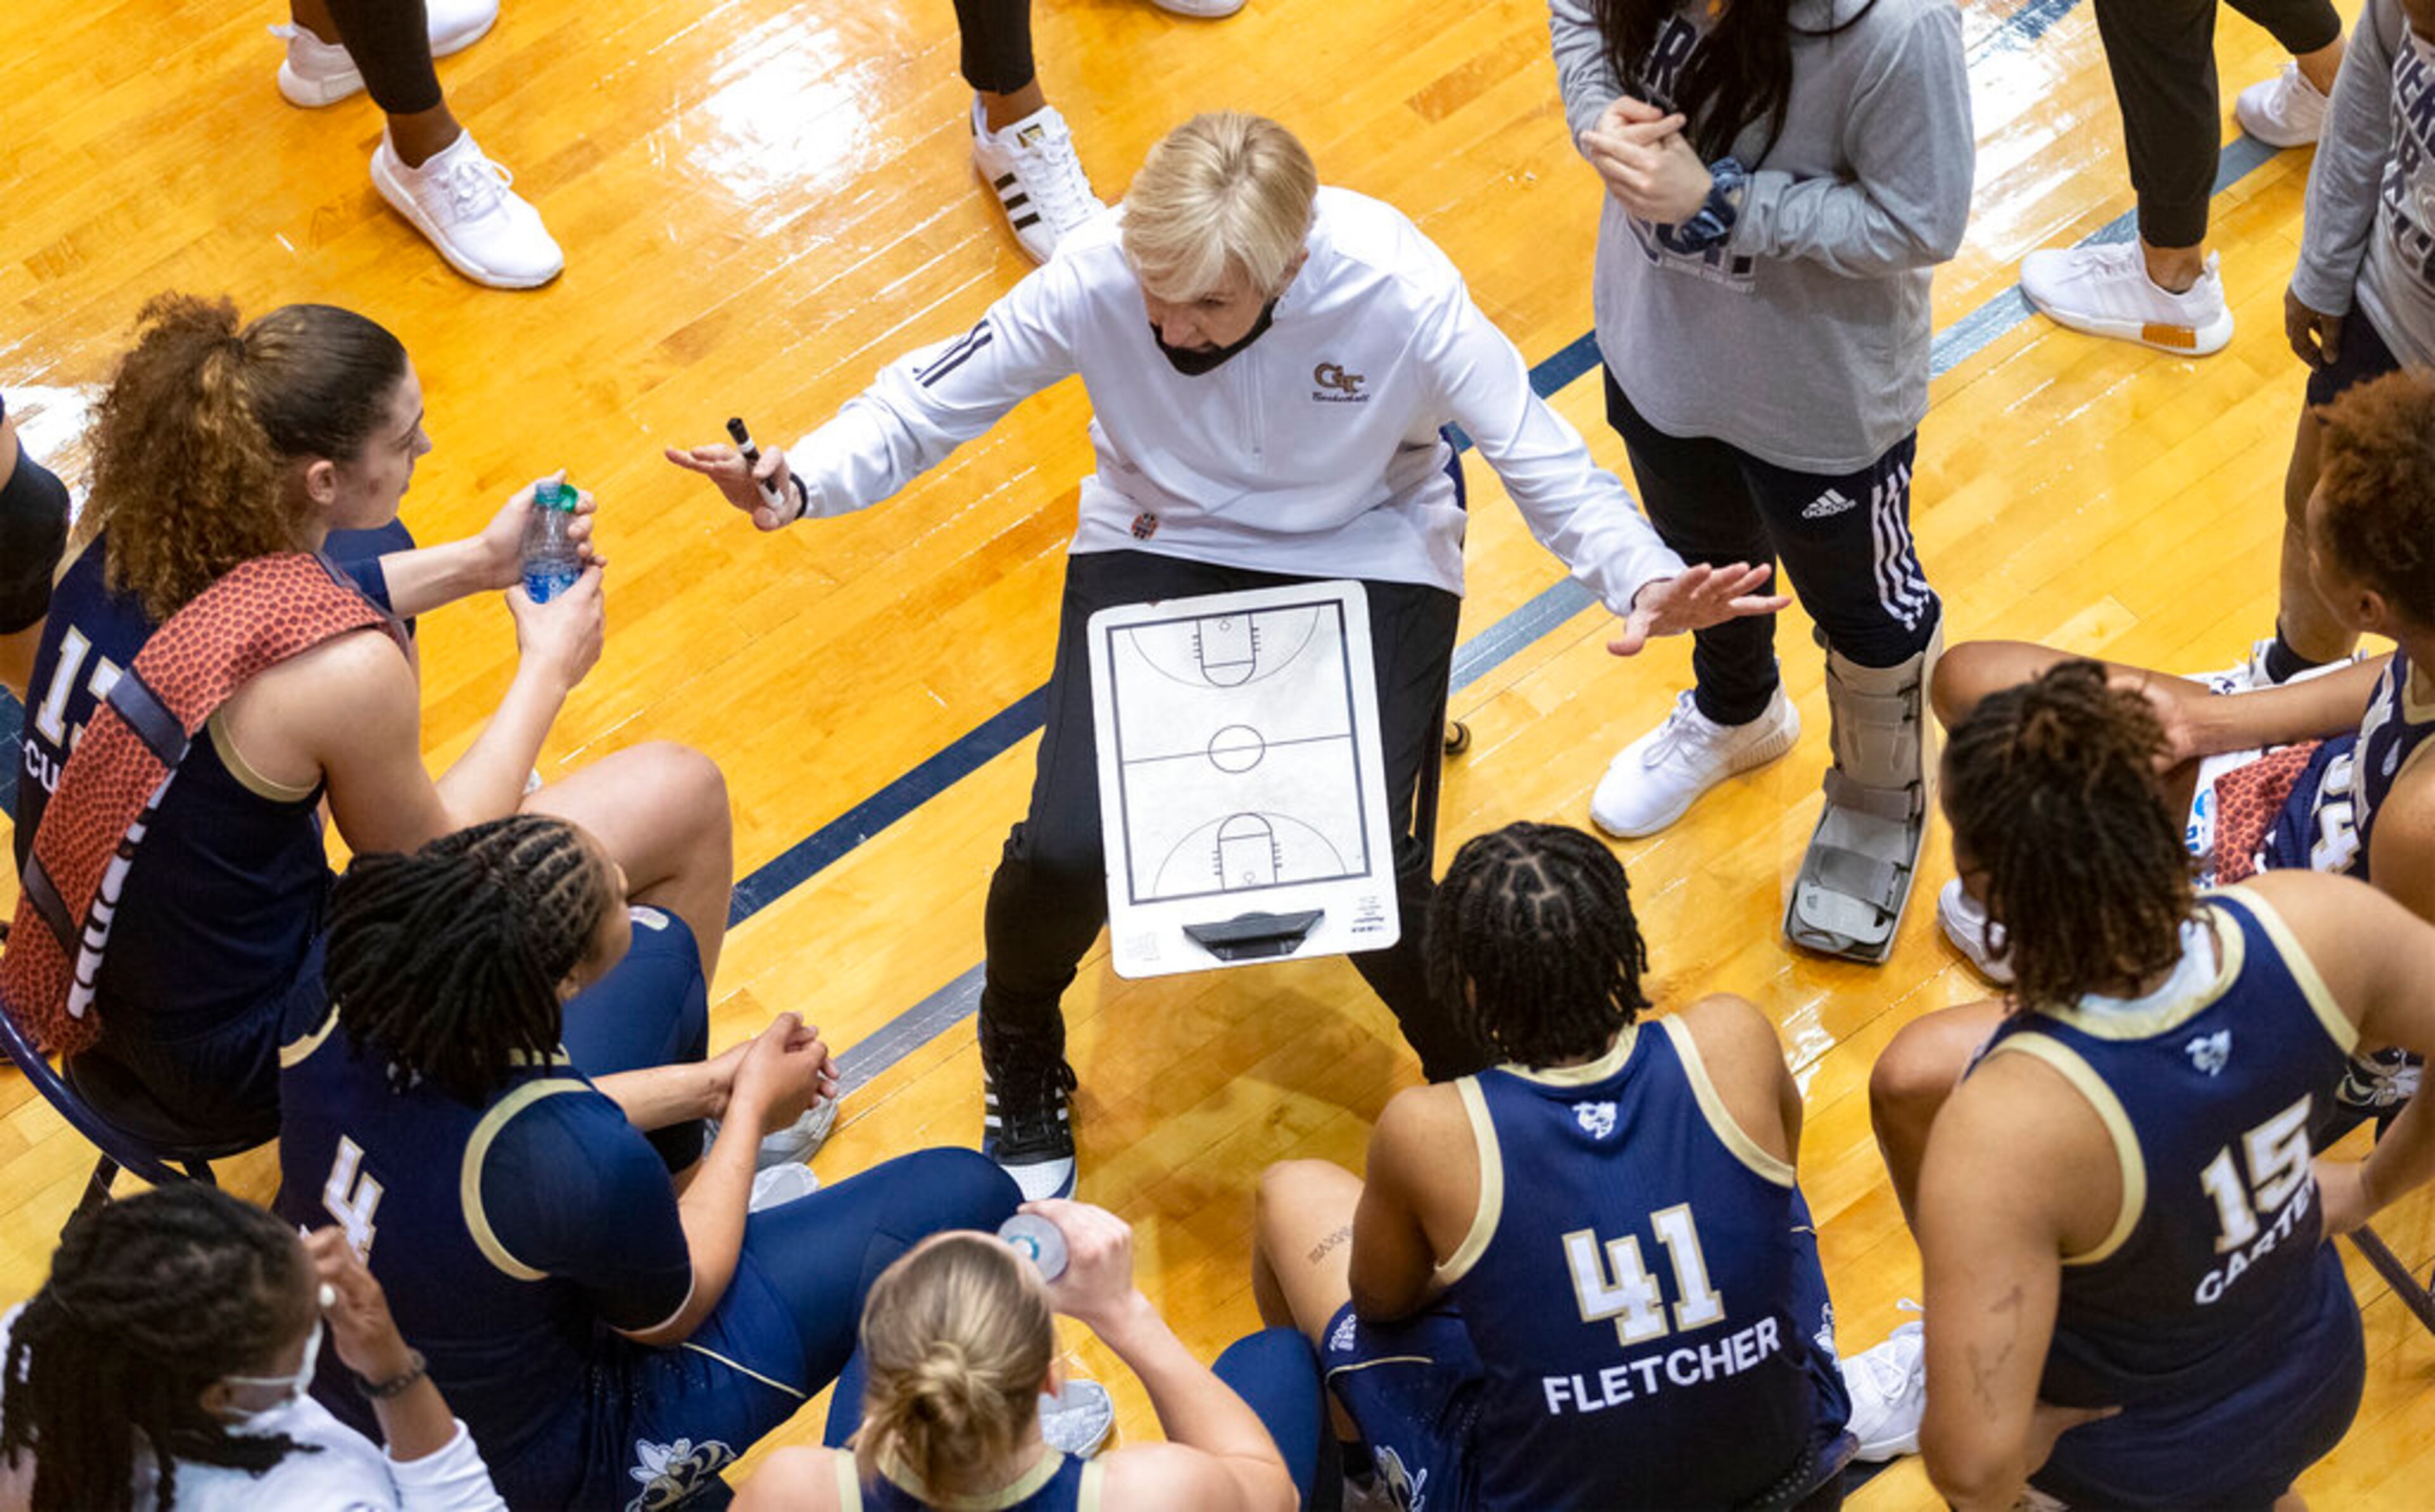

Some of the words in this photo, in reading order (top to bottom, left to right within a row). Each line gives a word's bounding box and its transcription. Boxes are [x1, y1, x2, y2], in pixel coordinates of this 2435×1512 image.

[25, 739, 61, 794] CU
[322, 1134, 385, 1268] 4
[2199, 1092, 2313, 1255] 15
[1561, 1202, 1726, 1347] 41
[1543, 1315, 1781, 1415] FLETCHER
